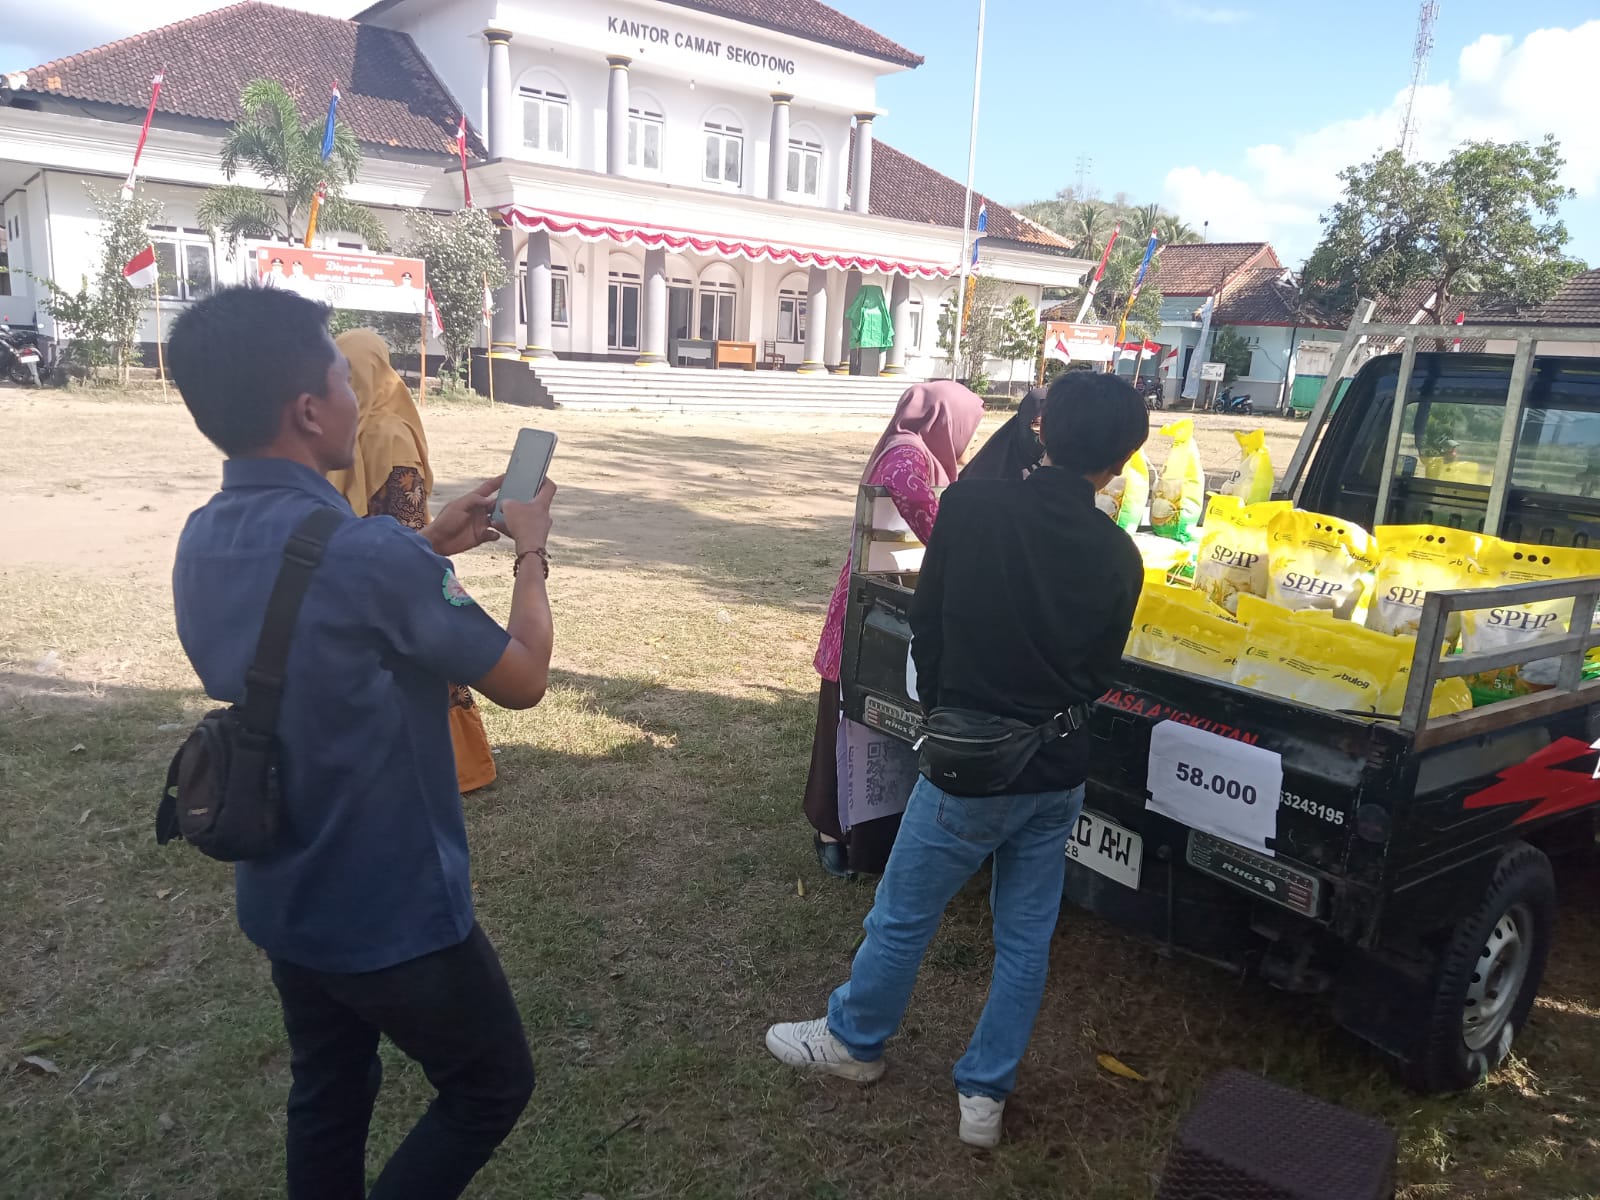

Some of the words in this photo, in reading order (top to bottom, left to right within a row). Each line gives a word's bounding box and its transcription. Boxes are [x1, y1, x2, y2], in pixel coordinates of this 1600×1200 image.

[608, 16, 669, 45] KANTOR
[674, 32, 721, 57] CAMAT
[726, 45, 795, 75] SEKOTONG
[1211, 544, 1259, 569] SPHP
[1282, 572, 1343, 596] SPHP
[1386, 586, 1426, 606] SPH
[1487, 608, 1557, 630] SPHP
[1341, 673, 1371, 689] bulog
[1494, 678, 1502, 689] 5
[1096, 688, 1143, 715] JASA
[1176, 761, 1258, 805] 58.000
[1098, 826, 1133, 866] AW
[1221, 862, 1263, 885] RHGS
